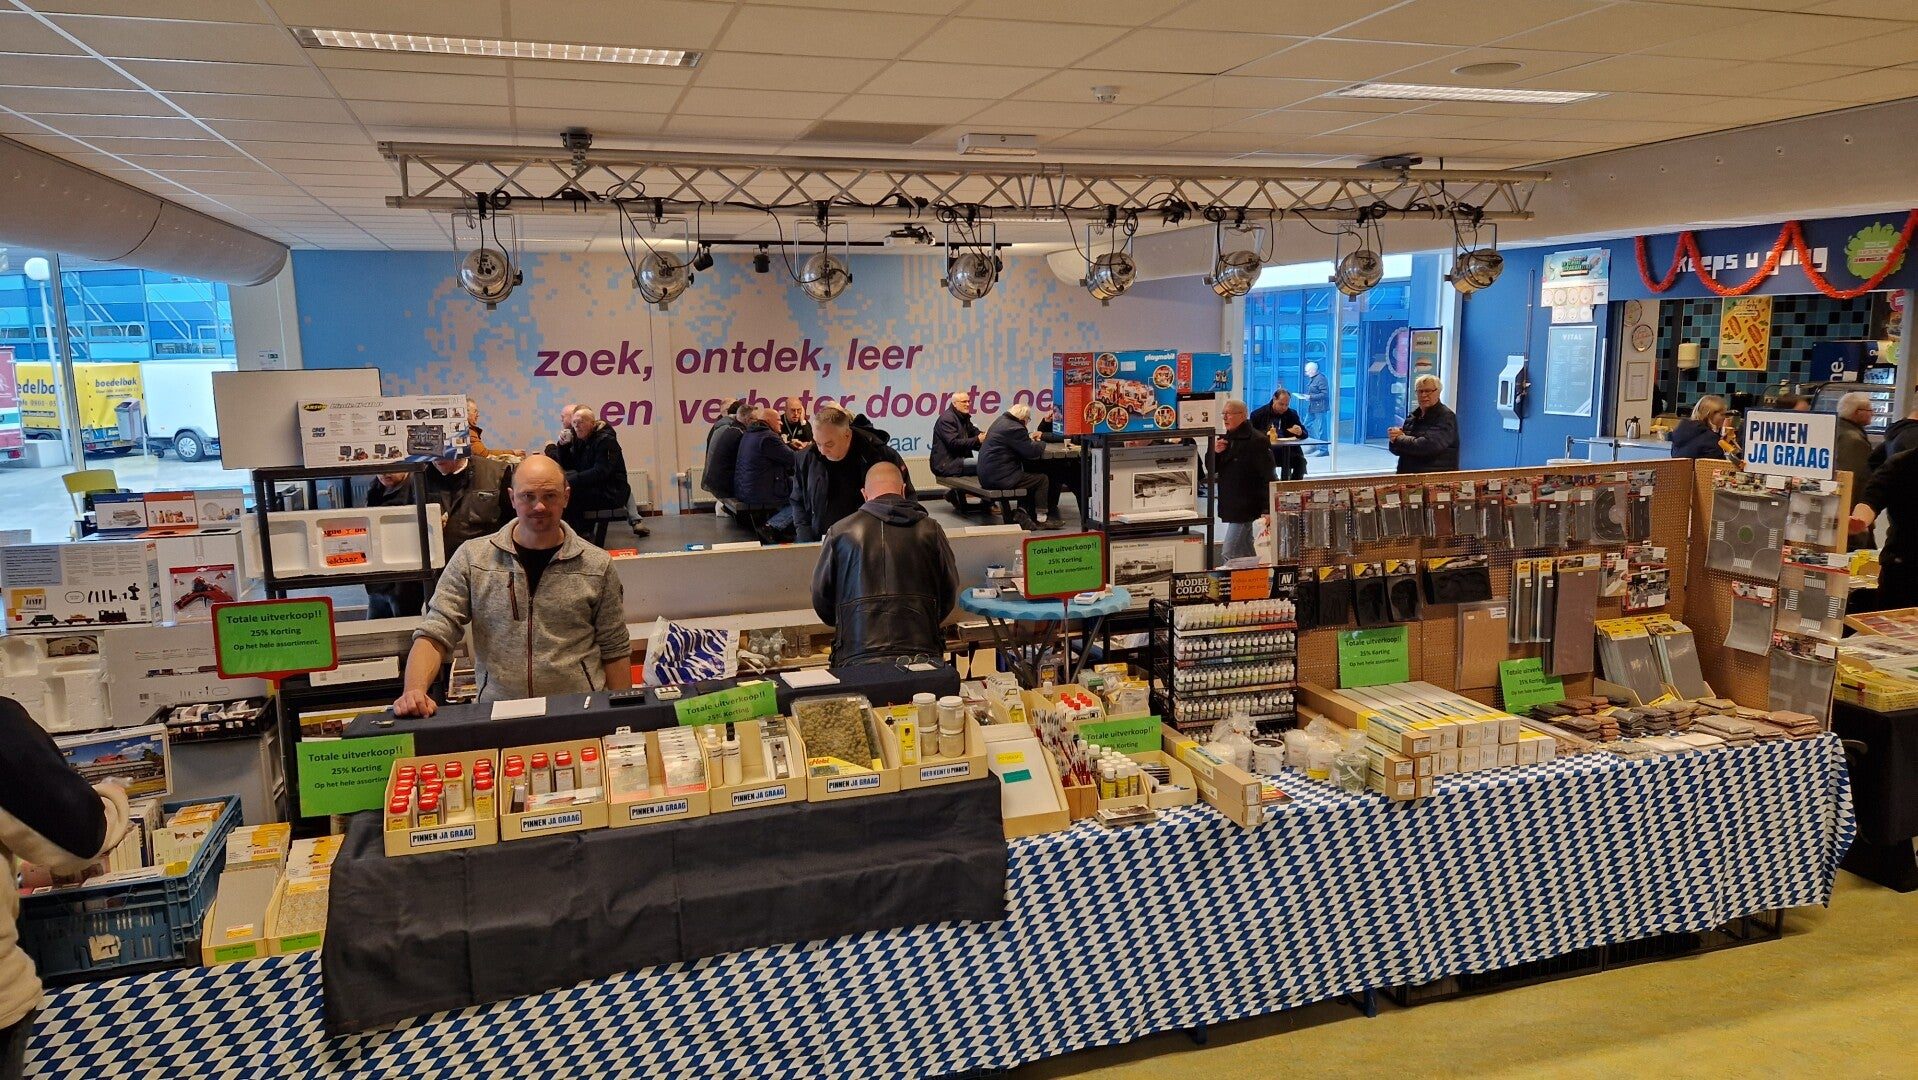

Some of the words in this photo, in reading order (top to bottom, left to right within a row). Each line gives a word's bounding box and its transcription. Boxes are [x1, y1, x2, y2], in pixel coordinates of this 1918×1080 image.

[1746, 252, 1759, 268] u
[534, 341, 652, 382] zoek,
[676, 339, 832, 378] ontdek,
[846, 338, 922, 371] leer
[1144, 352, 1176, 362] playmobil
[17, 379, 62, 394] edelba
[96, 378, 137, 387] boedelbak
[600, 400, 653, 427] en
[866, 386, 953, 418] door
[968, 385, 1000, 414] te
[1750, 420, 1808, 444] PINNEN
[1748, 443, 1768, 464] JA
[1774, 446, 1829, 469] GRAAG
[1056, 542, 1097, 552] uitverkoop!!
[1176, 578, 1210, 587] MODEL
[1176, 585, 1209, 594] COLOR
[226, 614, 258, 624] Totale
[260, 610, 322, 622] uitverkoop!!
[270, 627, 302, 636] Korting
[1366, 636, 1402, 645] uitverkoop!!
[686, 705, 712, 715] Totale
[714, 691, 766, 708] uitverkoop!!
[723, 707, 750, 718] Korting
[1087, 732, 1109, 740] Totale
[1110, 726, 1154, 738] uitverkoop!!
[308, 753, 339, 762] Totale
[342, 746, 403, 760] uitverkoop!!
[352, 764, 382, 773] Korting
[951, 766, 968, 775] PINNEN
[828, 780, 849, 789] PINNEN
[859, 777, 878, 785] GRAAG
[734, 793, 755, 802] PINNEN
[764, 789, 784, 798] GRAAG
[632, 806, 655, 816] PINNEN
[666, 802, 686, 811] GRAAG
[523, 818, 546, 828] PINNEN
[558, 814, 579, 824] GRAAG
[412, 833, 437, 842] PINNEN
[450, 829, 473, 838] GRAAG
